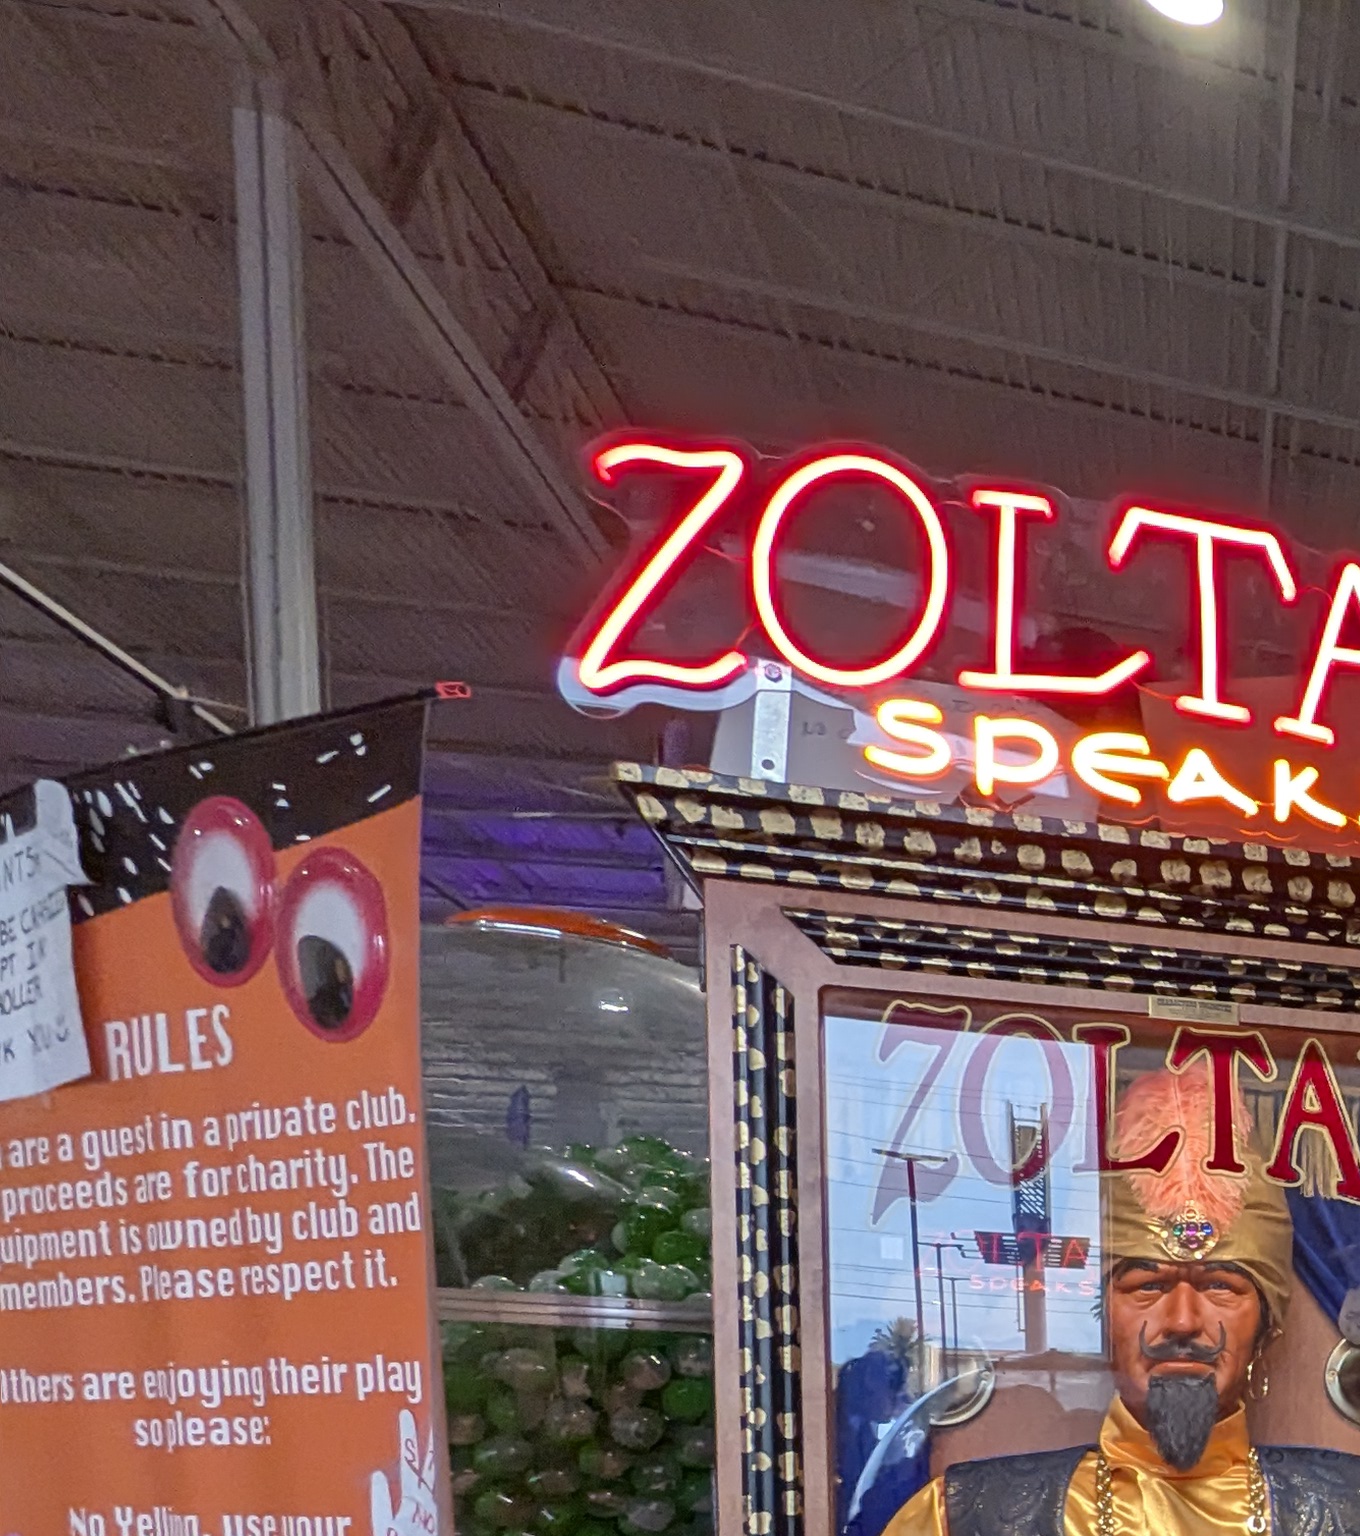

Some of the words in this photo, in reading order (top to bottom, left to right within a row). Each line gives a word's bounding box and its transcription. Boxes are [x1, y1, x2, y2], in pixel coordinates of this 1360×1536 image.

[104, 1004, 233, 1082] RULES
[9, 1136, 49, 1169] are
[57, 1133, 74, 1163] a
[82, 1115, 154, 1172] guest
[161, 1113, 194, 1150] in
[204, 1117, 221, 1147] a
[226, 1097, 336, 1152] private
[346, 1086, 417, 1132] club.
[2, 1171, 128, 1224] proceeds
[135, 1168, 172, 1204] are
[183, 1160, 230, 1199] for
[237, 1147, 359, 1198] charity.
[363, 1142, 415, 1183] The
[120, 1219, 142, 1255] is
[147, 1207, 242, 1252] owned
[247, 1209, 283, 1255] by
[292, 1198, 360, 1241] club
[368, 1192, 422, 1236] and
[0, 1272, 136, 1312] members.
[141, 1264, 235, 1302] Please
[241, 1251, 355, 1300] respect
[364, 1248, 398, 1290] it.
[82, 1370, 136, 1401] are
[143, 1359, 266, 1409] enjoying
[270, 1355, 347, 1397] their
[356, 1353, 422, 1404] play
[134, 1416, 162, 1447] so
[166, 1409, 272, 1454] please:
